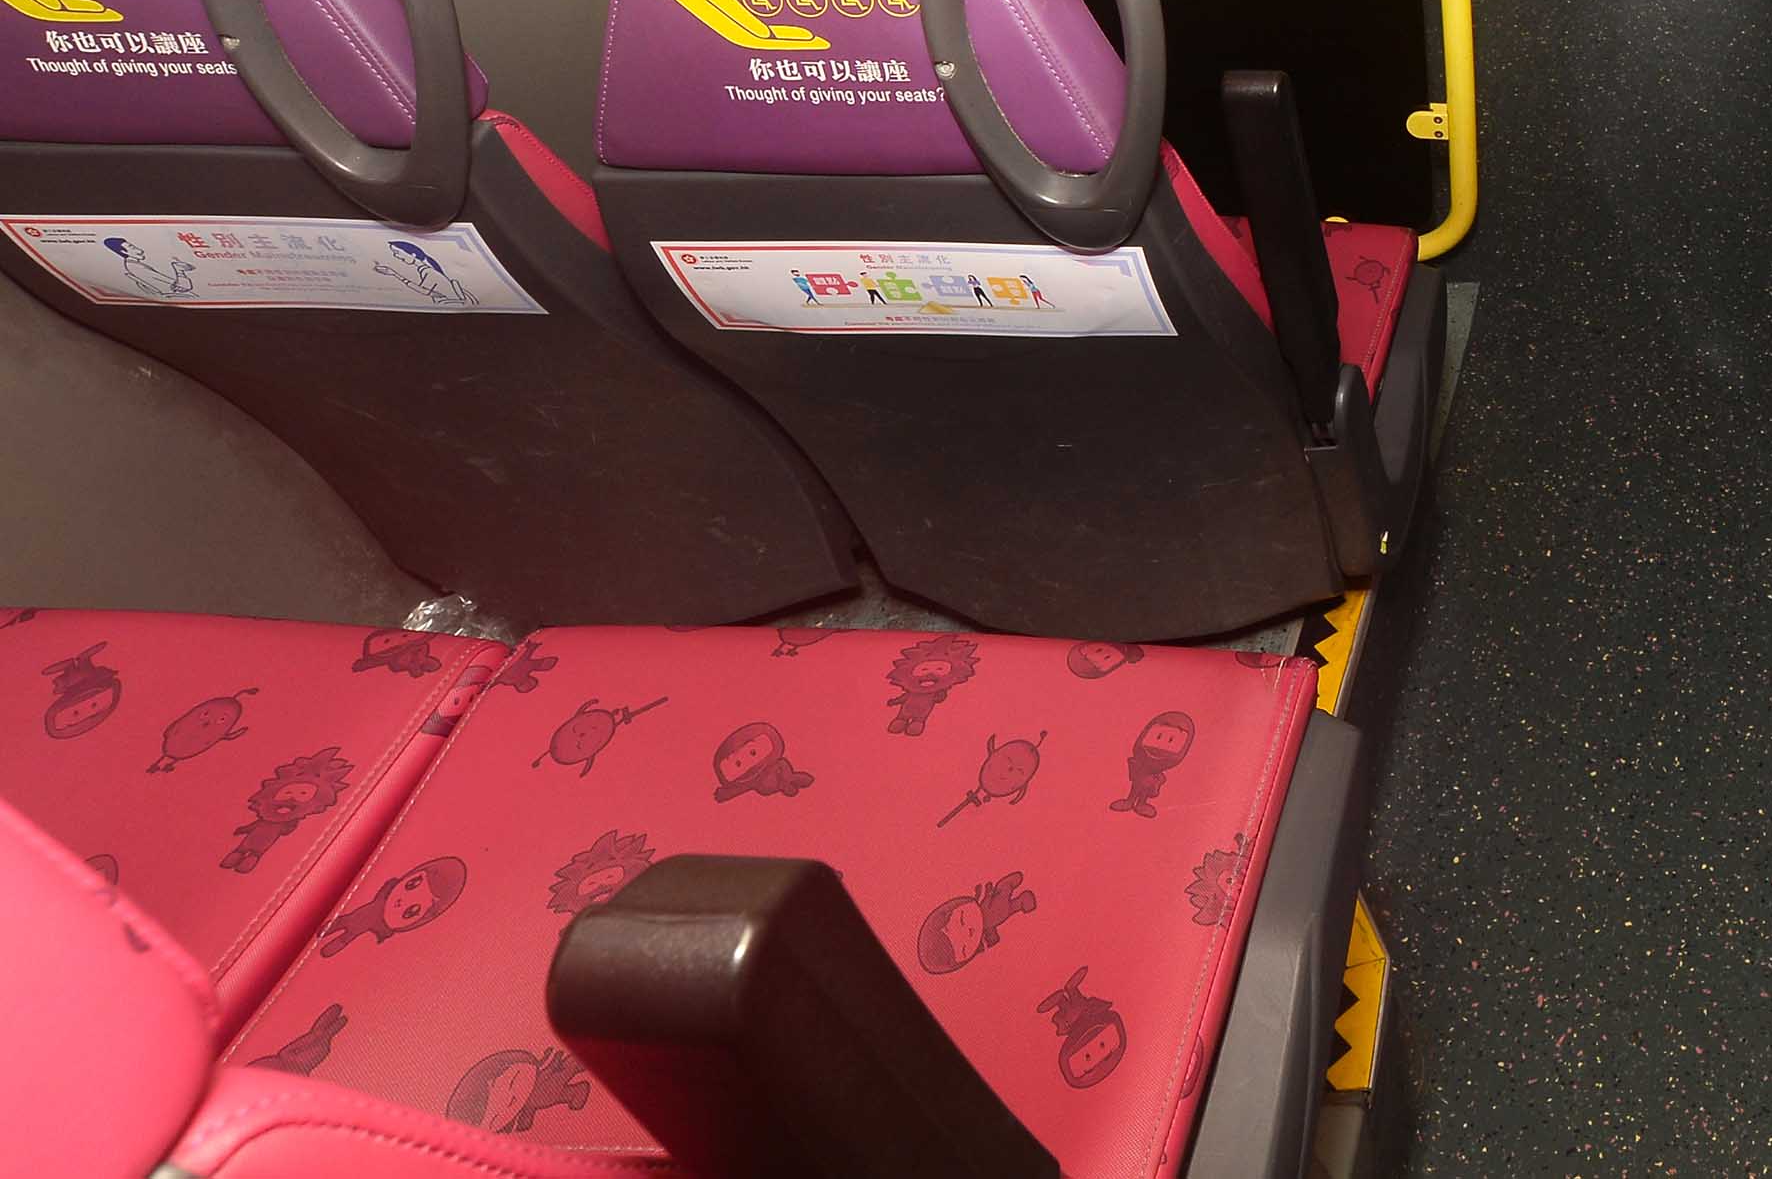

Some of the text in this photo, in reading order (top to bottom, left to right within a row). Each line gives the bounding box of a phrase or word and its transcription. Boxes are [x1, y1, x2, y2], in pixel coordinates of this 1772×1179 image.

[46, 30, 208, 55] 你也可以讓座
[26, 57, 92, 76] Thought
[93, 60, 108, 73] of
[111, 60, 158, 77] giving
[158, 62, 193, 76] your
[749, 58, 911, 83] 你也可以讓座
[724, 85, 945, 105] Thought of giving your seats?
[177, 232, 345, 251] 性別主流化
[194, 250, 246, 259] Gender
